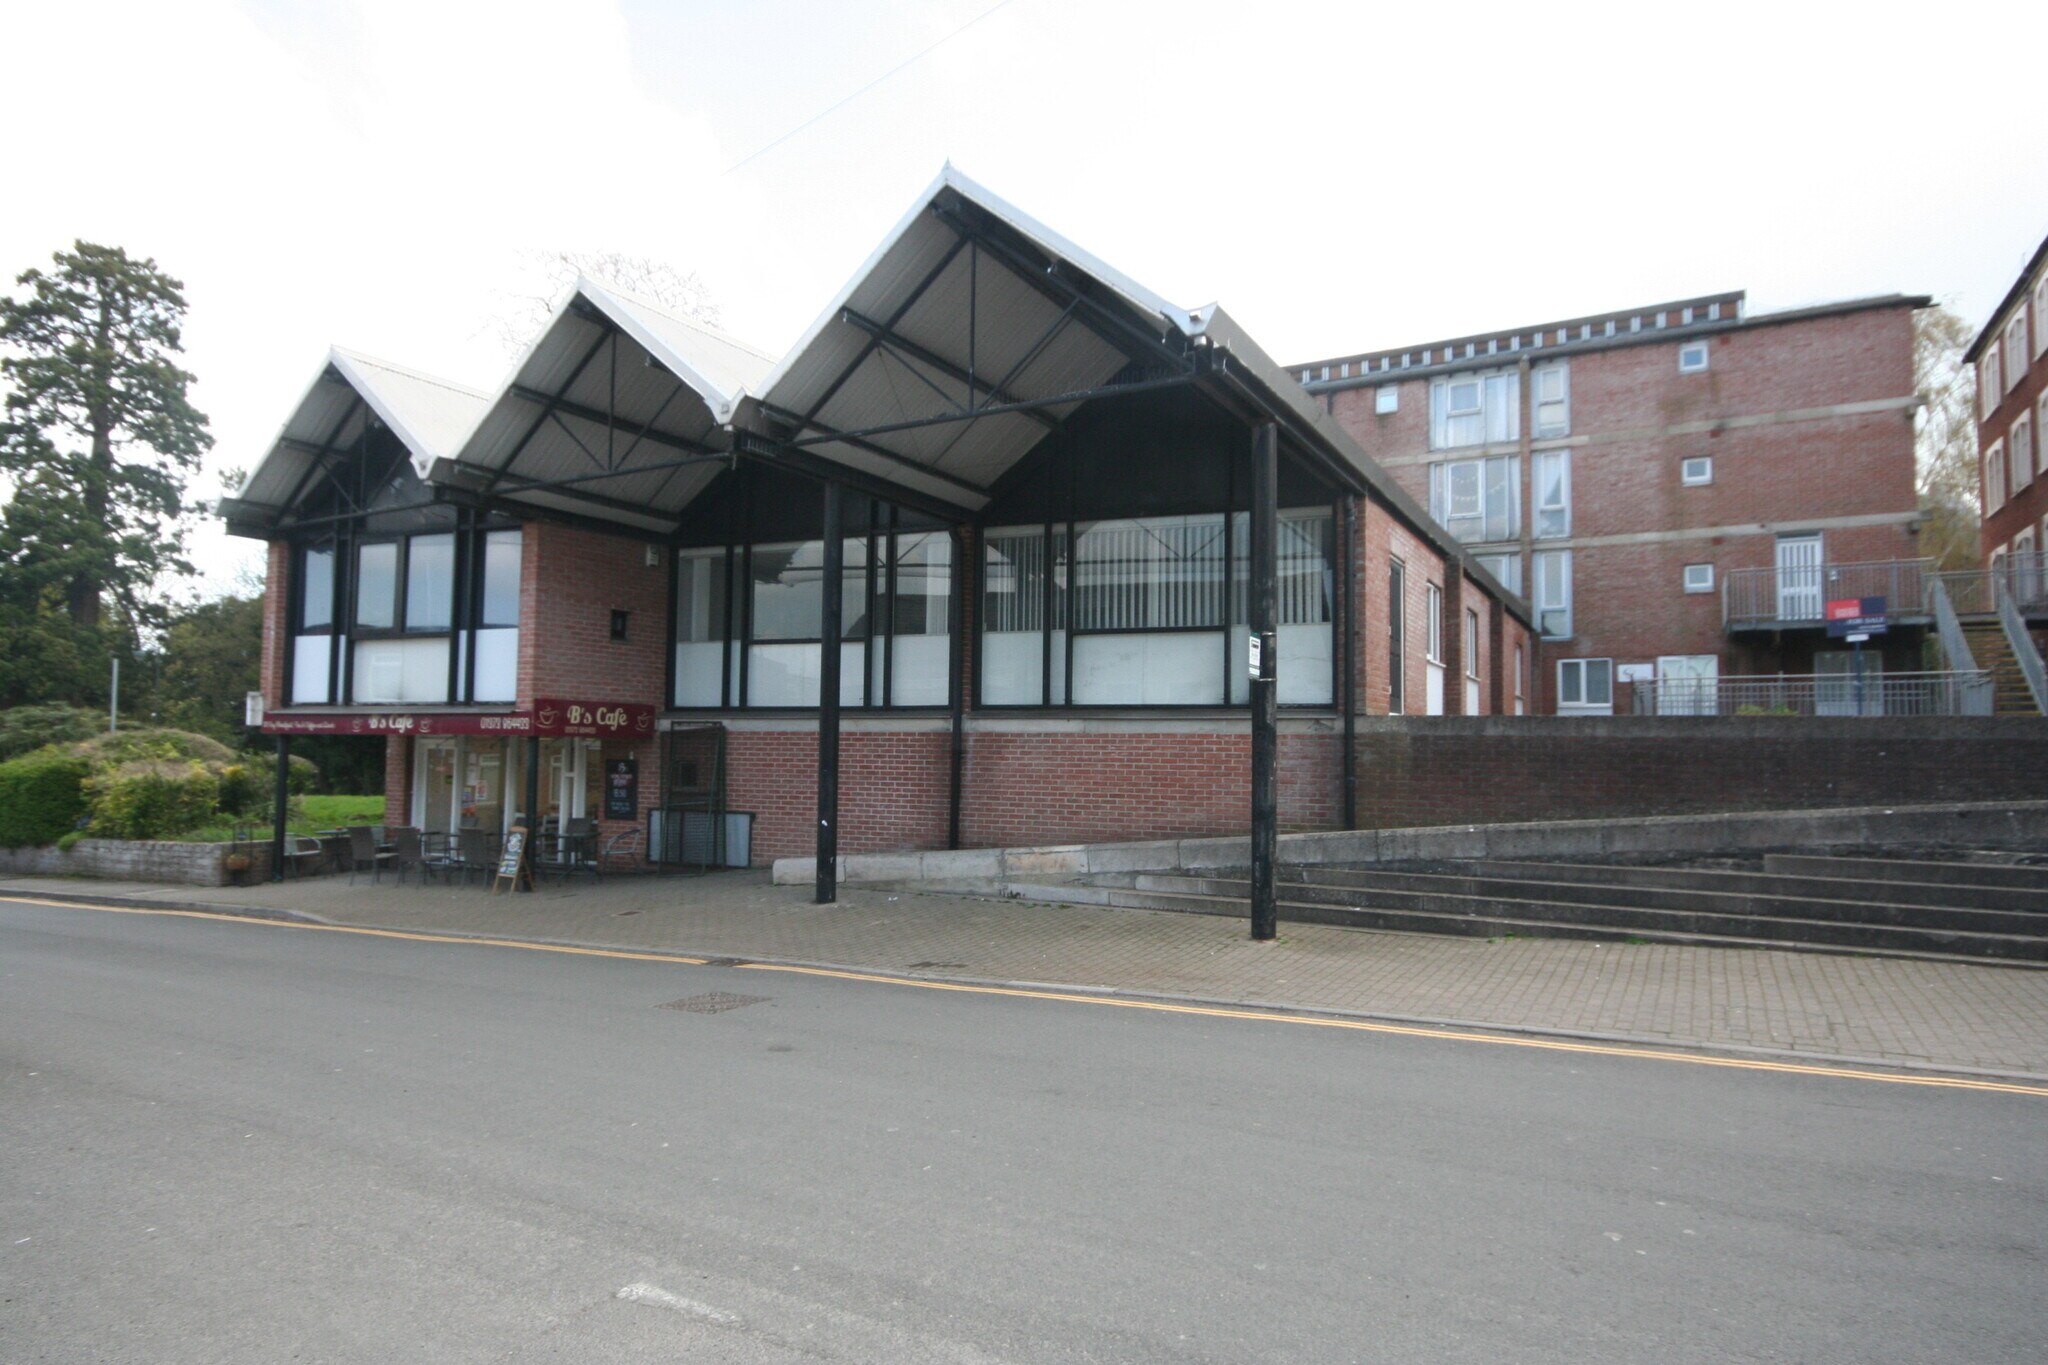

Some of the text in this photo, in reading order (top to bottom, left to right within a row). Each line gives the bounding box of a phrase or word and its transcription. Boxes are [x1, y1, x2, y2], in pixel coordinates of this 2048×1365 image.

[389, 714, 414, 733] Cafe
[567, 705, 592, 724] B's
[596, 707, 628, 731] Cafe
